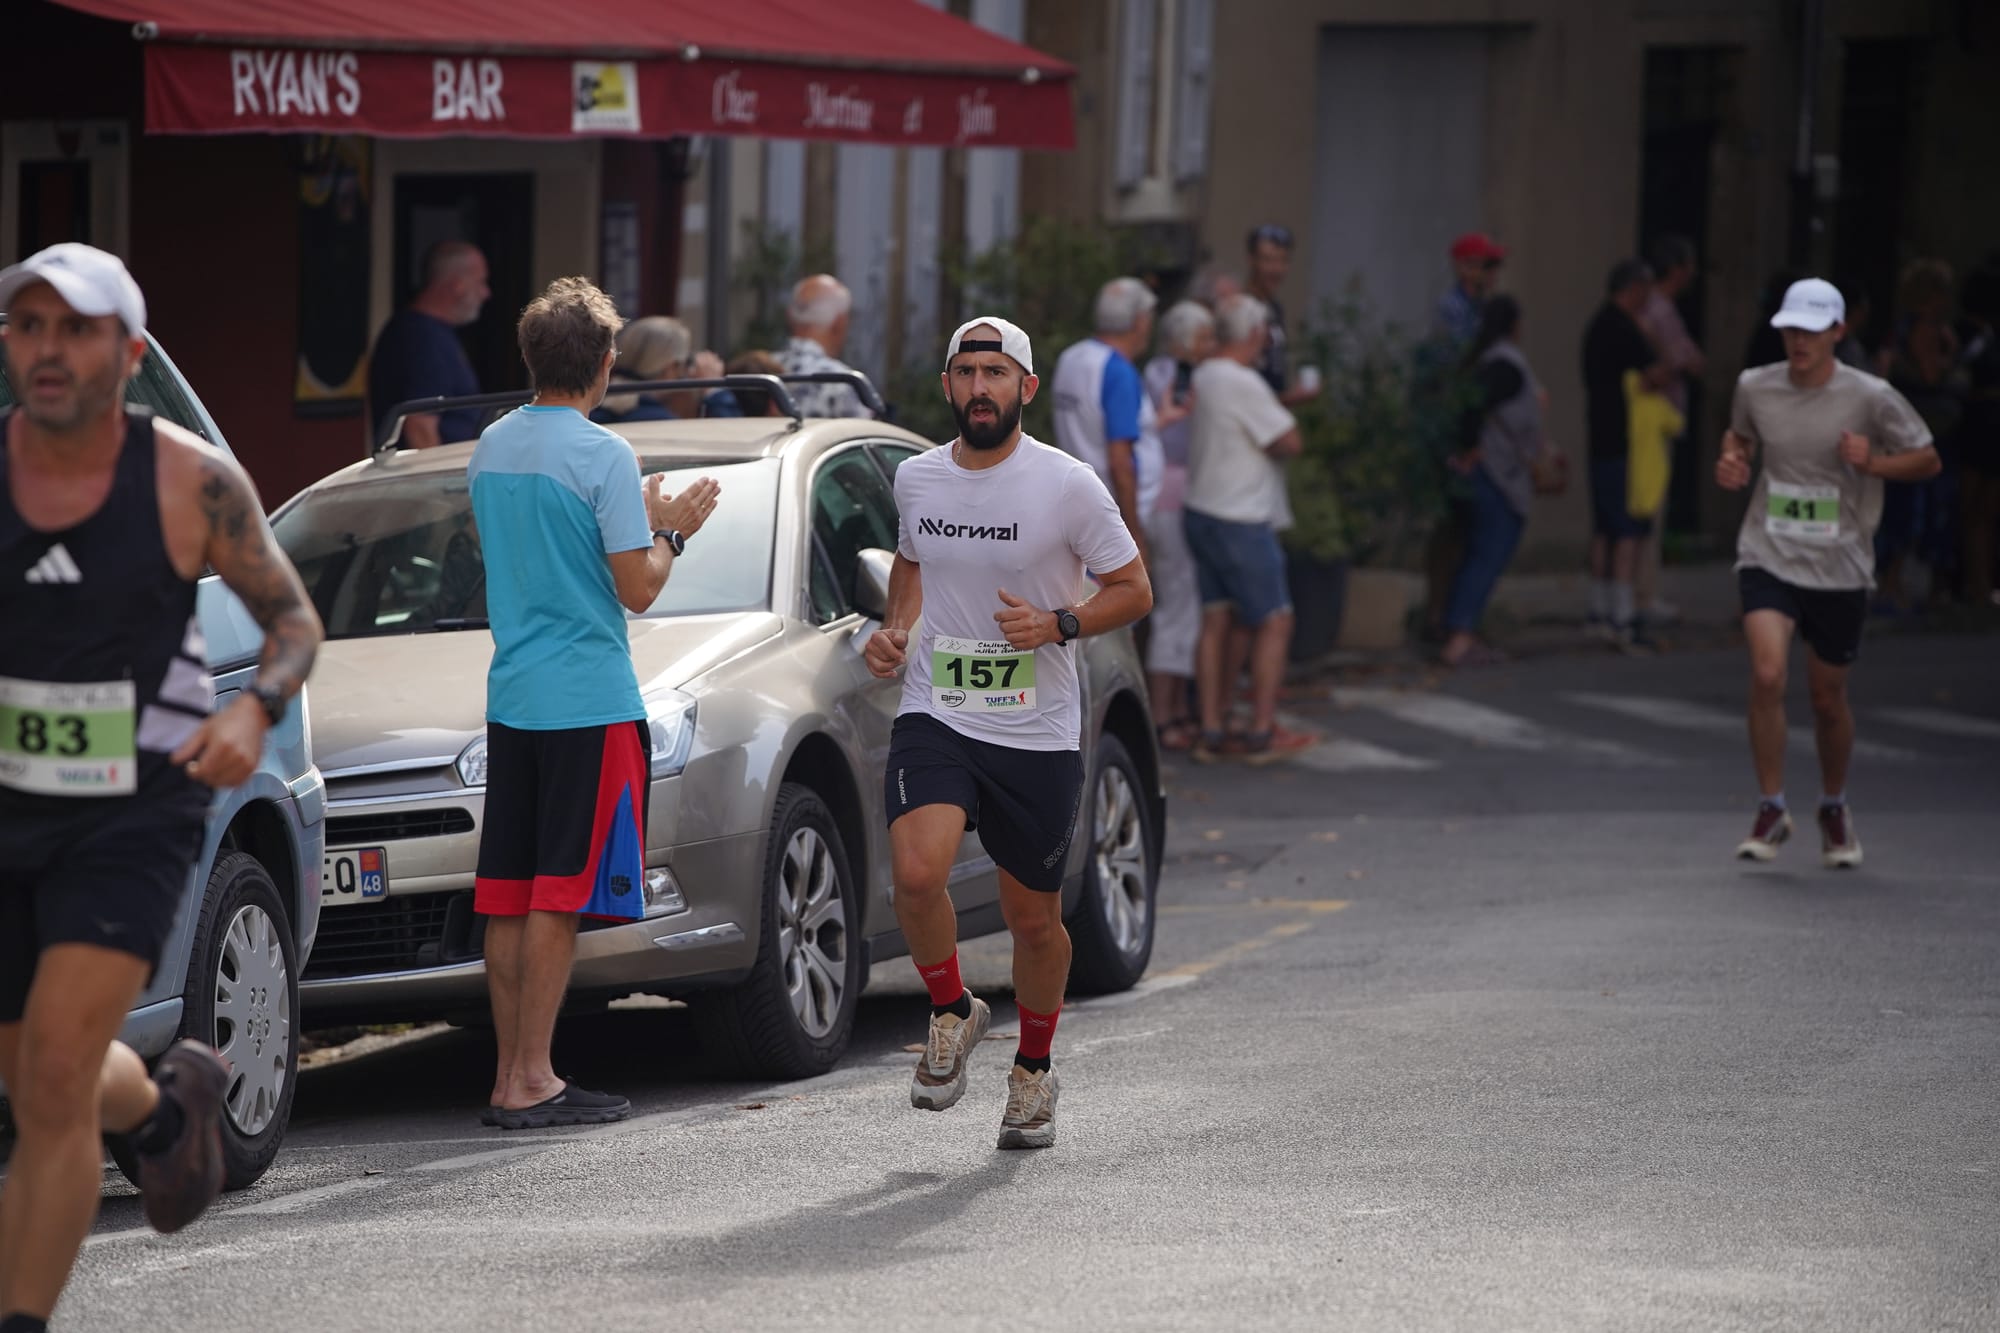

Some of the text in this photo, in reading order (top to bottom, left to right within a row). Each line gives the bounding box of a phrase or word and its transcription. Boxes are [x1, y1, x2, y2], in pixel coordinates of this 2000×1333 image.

[231, 49, 361, 116] RYAN'S
[432, 59, 505, 121] BAR
[711, 70, 759, 126] Chez
[902, 95, 924, 134] et
[1784, 499, 1816, 520] 41
[946, 657, 1020, 689] 157
[984, 696, 1016, 705] TUFF'S
[18, 710, 89, 757] 83
[363, 875, 381, 893] 48
